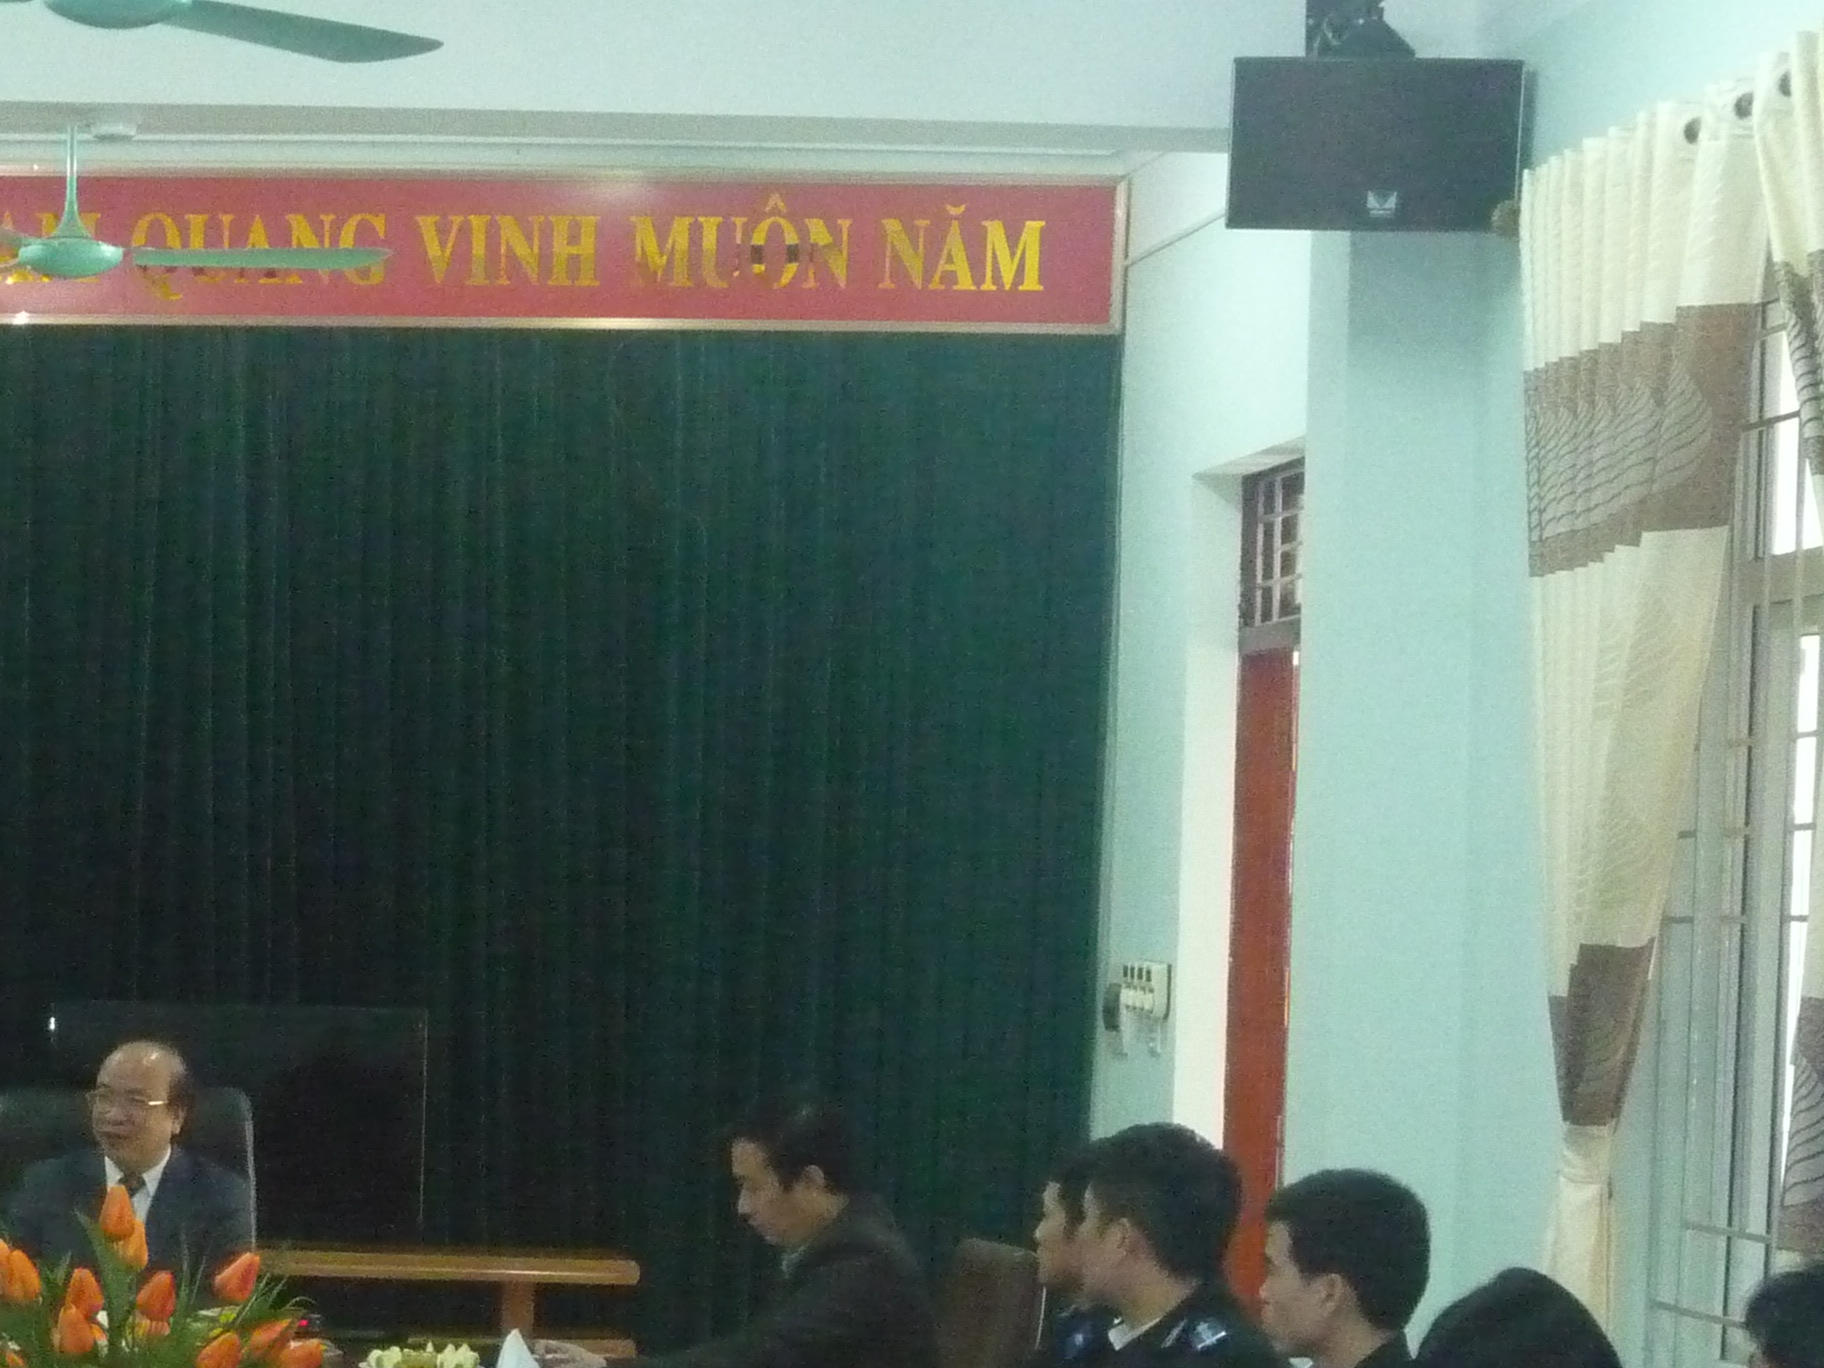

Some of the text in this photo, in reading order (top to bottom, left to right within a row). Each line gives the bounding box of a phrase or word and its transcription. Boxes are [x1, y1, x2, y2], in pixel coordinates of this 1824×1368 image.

[130, 211, 387, 300] QUANG
[415, 213, 601, 288] VINH
[629, 192, 853, 290] MUÔN
[877, 203, 1047, 291] NĂM
